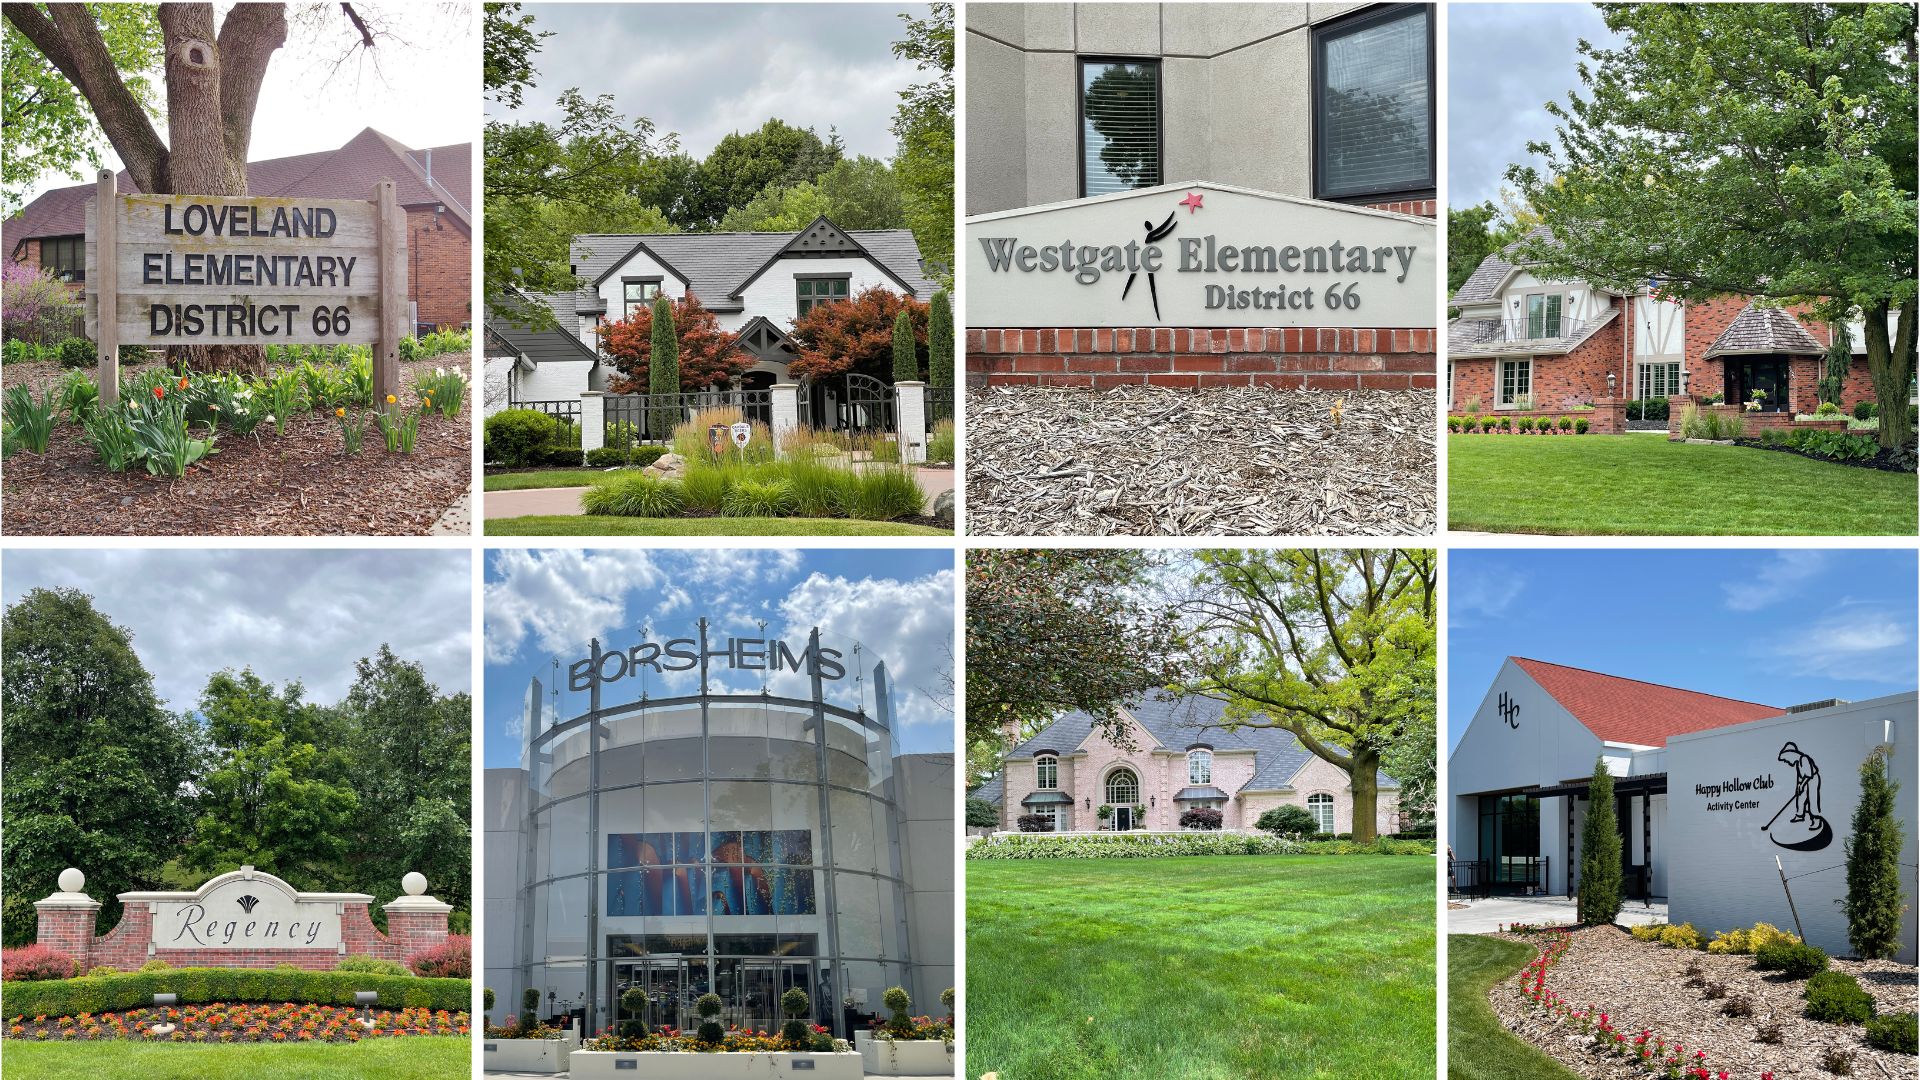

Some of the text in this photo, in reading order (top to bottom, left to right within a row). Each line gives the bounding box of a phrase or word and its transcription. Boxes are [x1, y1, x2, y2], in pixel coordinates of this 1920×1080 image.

[164, 203, 337, 239] LOVELAND
[143, 253, 357, 287] ELEMENTARY
[978, 235, 1417, 285] Westgate Elementary
[1204, 281, 1361, 310] District 66
[150, 303, 350, 337] DISTRICT 66
[568, 637, 846, 692] BORSHEIMS
[1695, 773, 1774, 798] Happy Hollow Club
[1706, 800, 1760, 812] Activity Center
[173, 904, 323, 946] Regency
